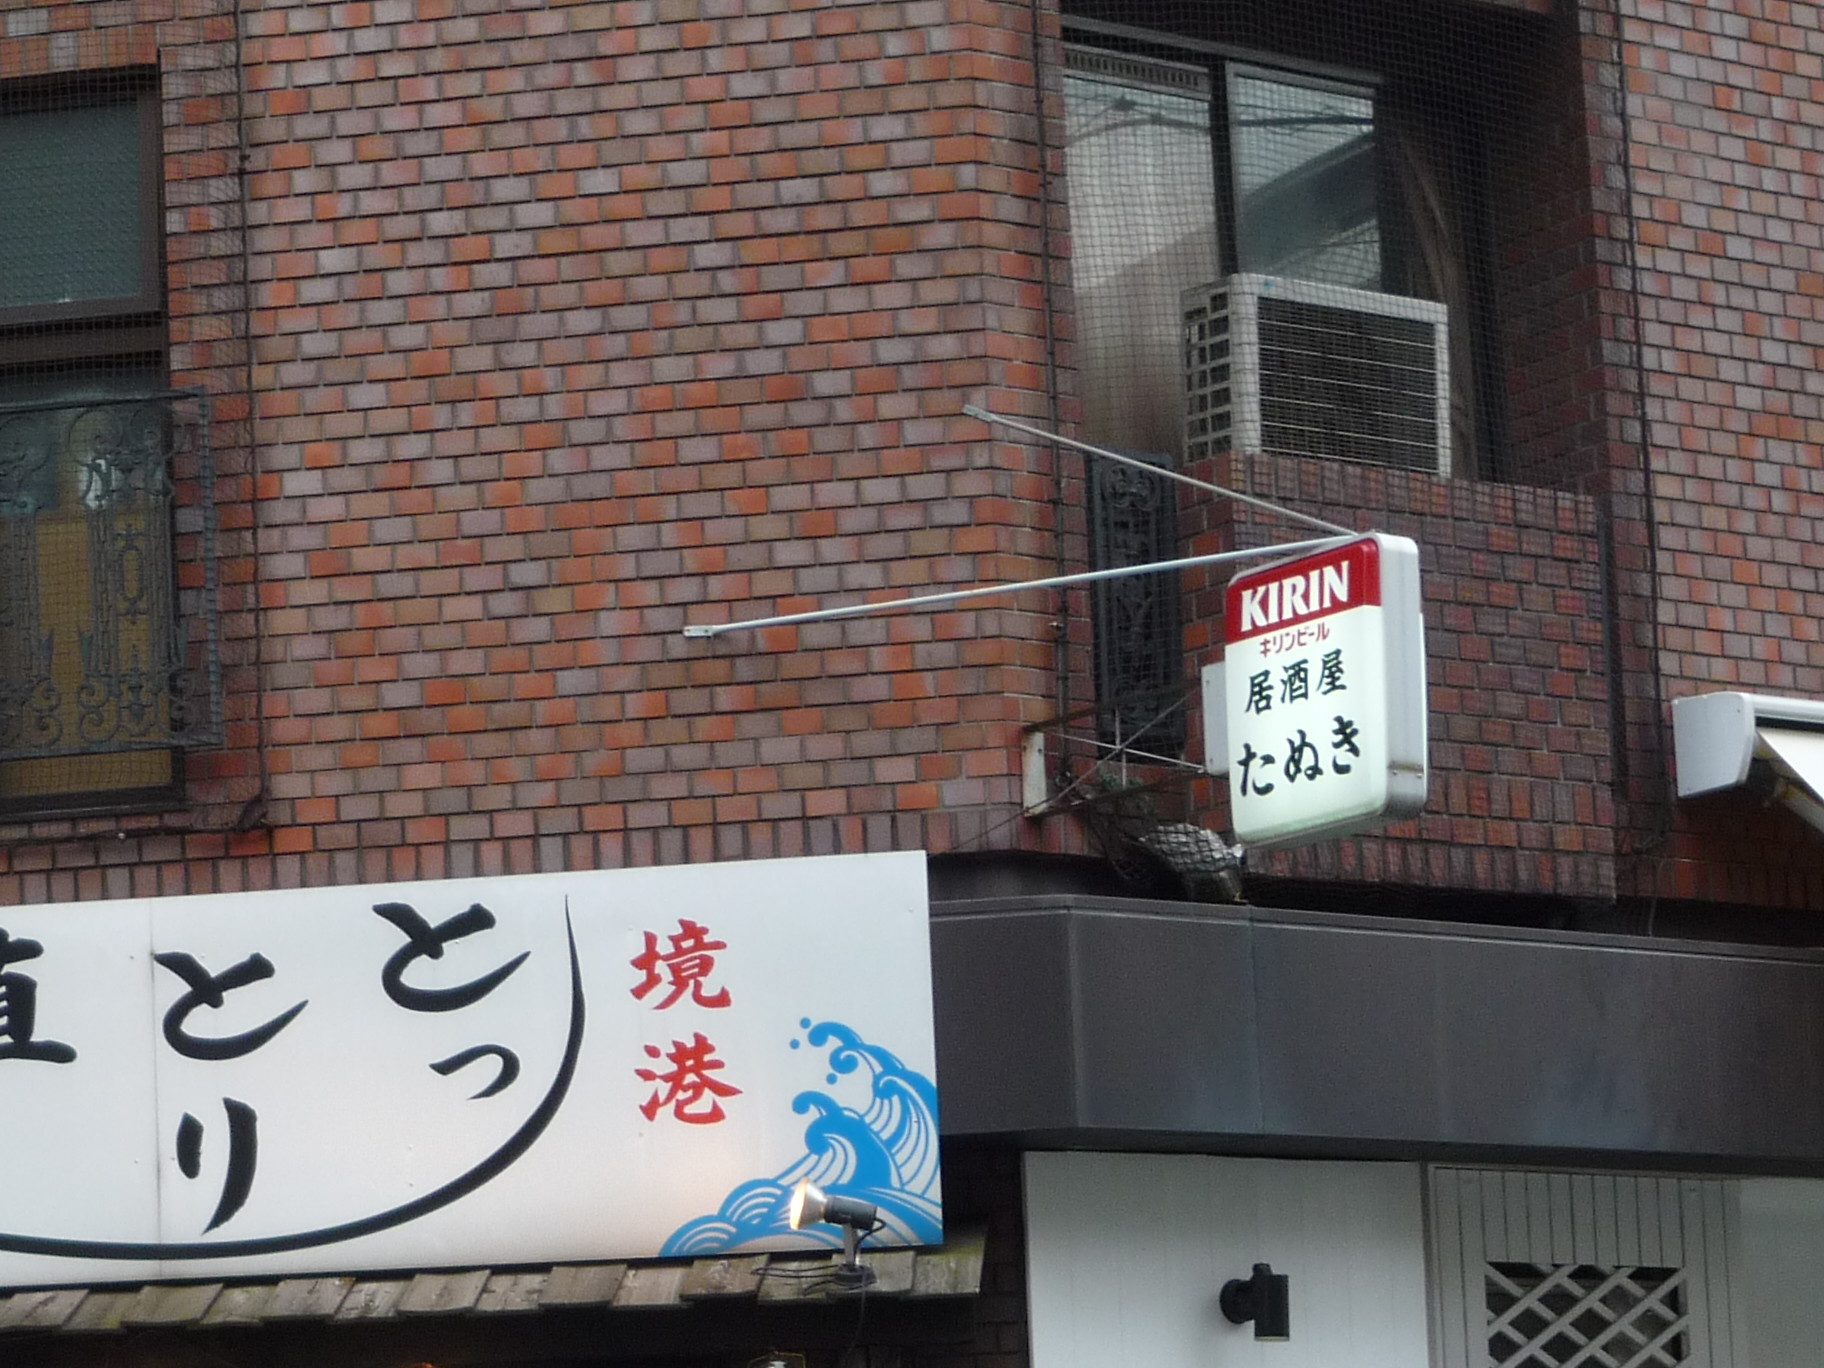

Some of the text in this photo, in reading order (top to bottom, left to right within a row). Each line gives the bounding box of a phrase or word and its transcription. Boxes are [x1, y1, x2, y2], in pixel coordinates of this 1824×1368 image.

[1241, 560, 1350, 632] KIRIN
[1260, 622, 1330, 657] キリンビール
[1245, 649, 1347, 715] 居酒屋
[1237, 716, 1360, 797] たぬき
[630, 919, 743, 1124] 境港
